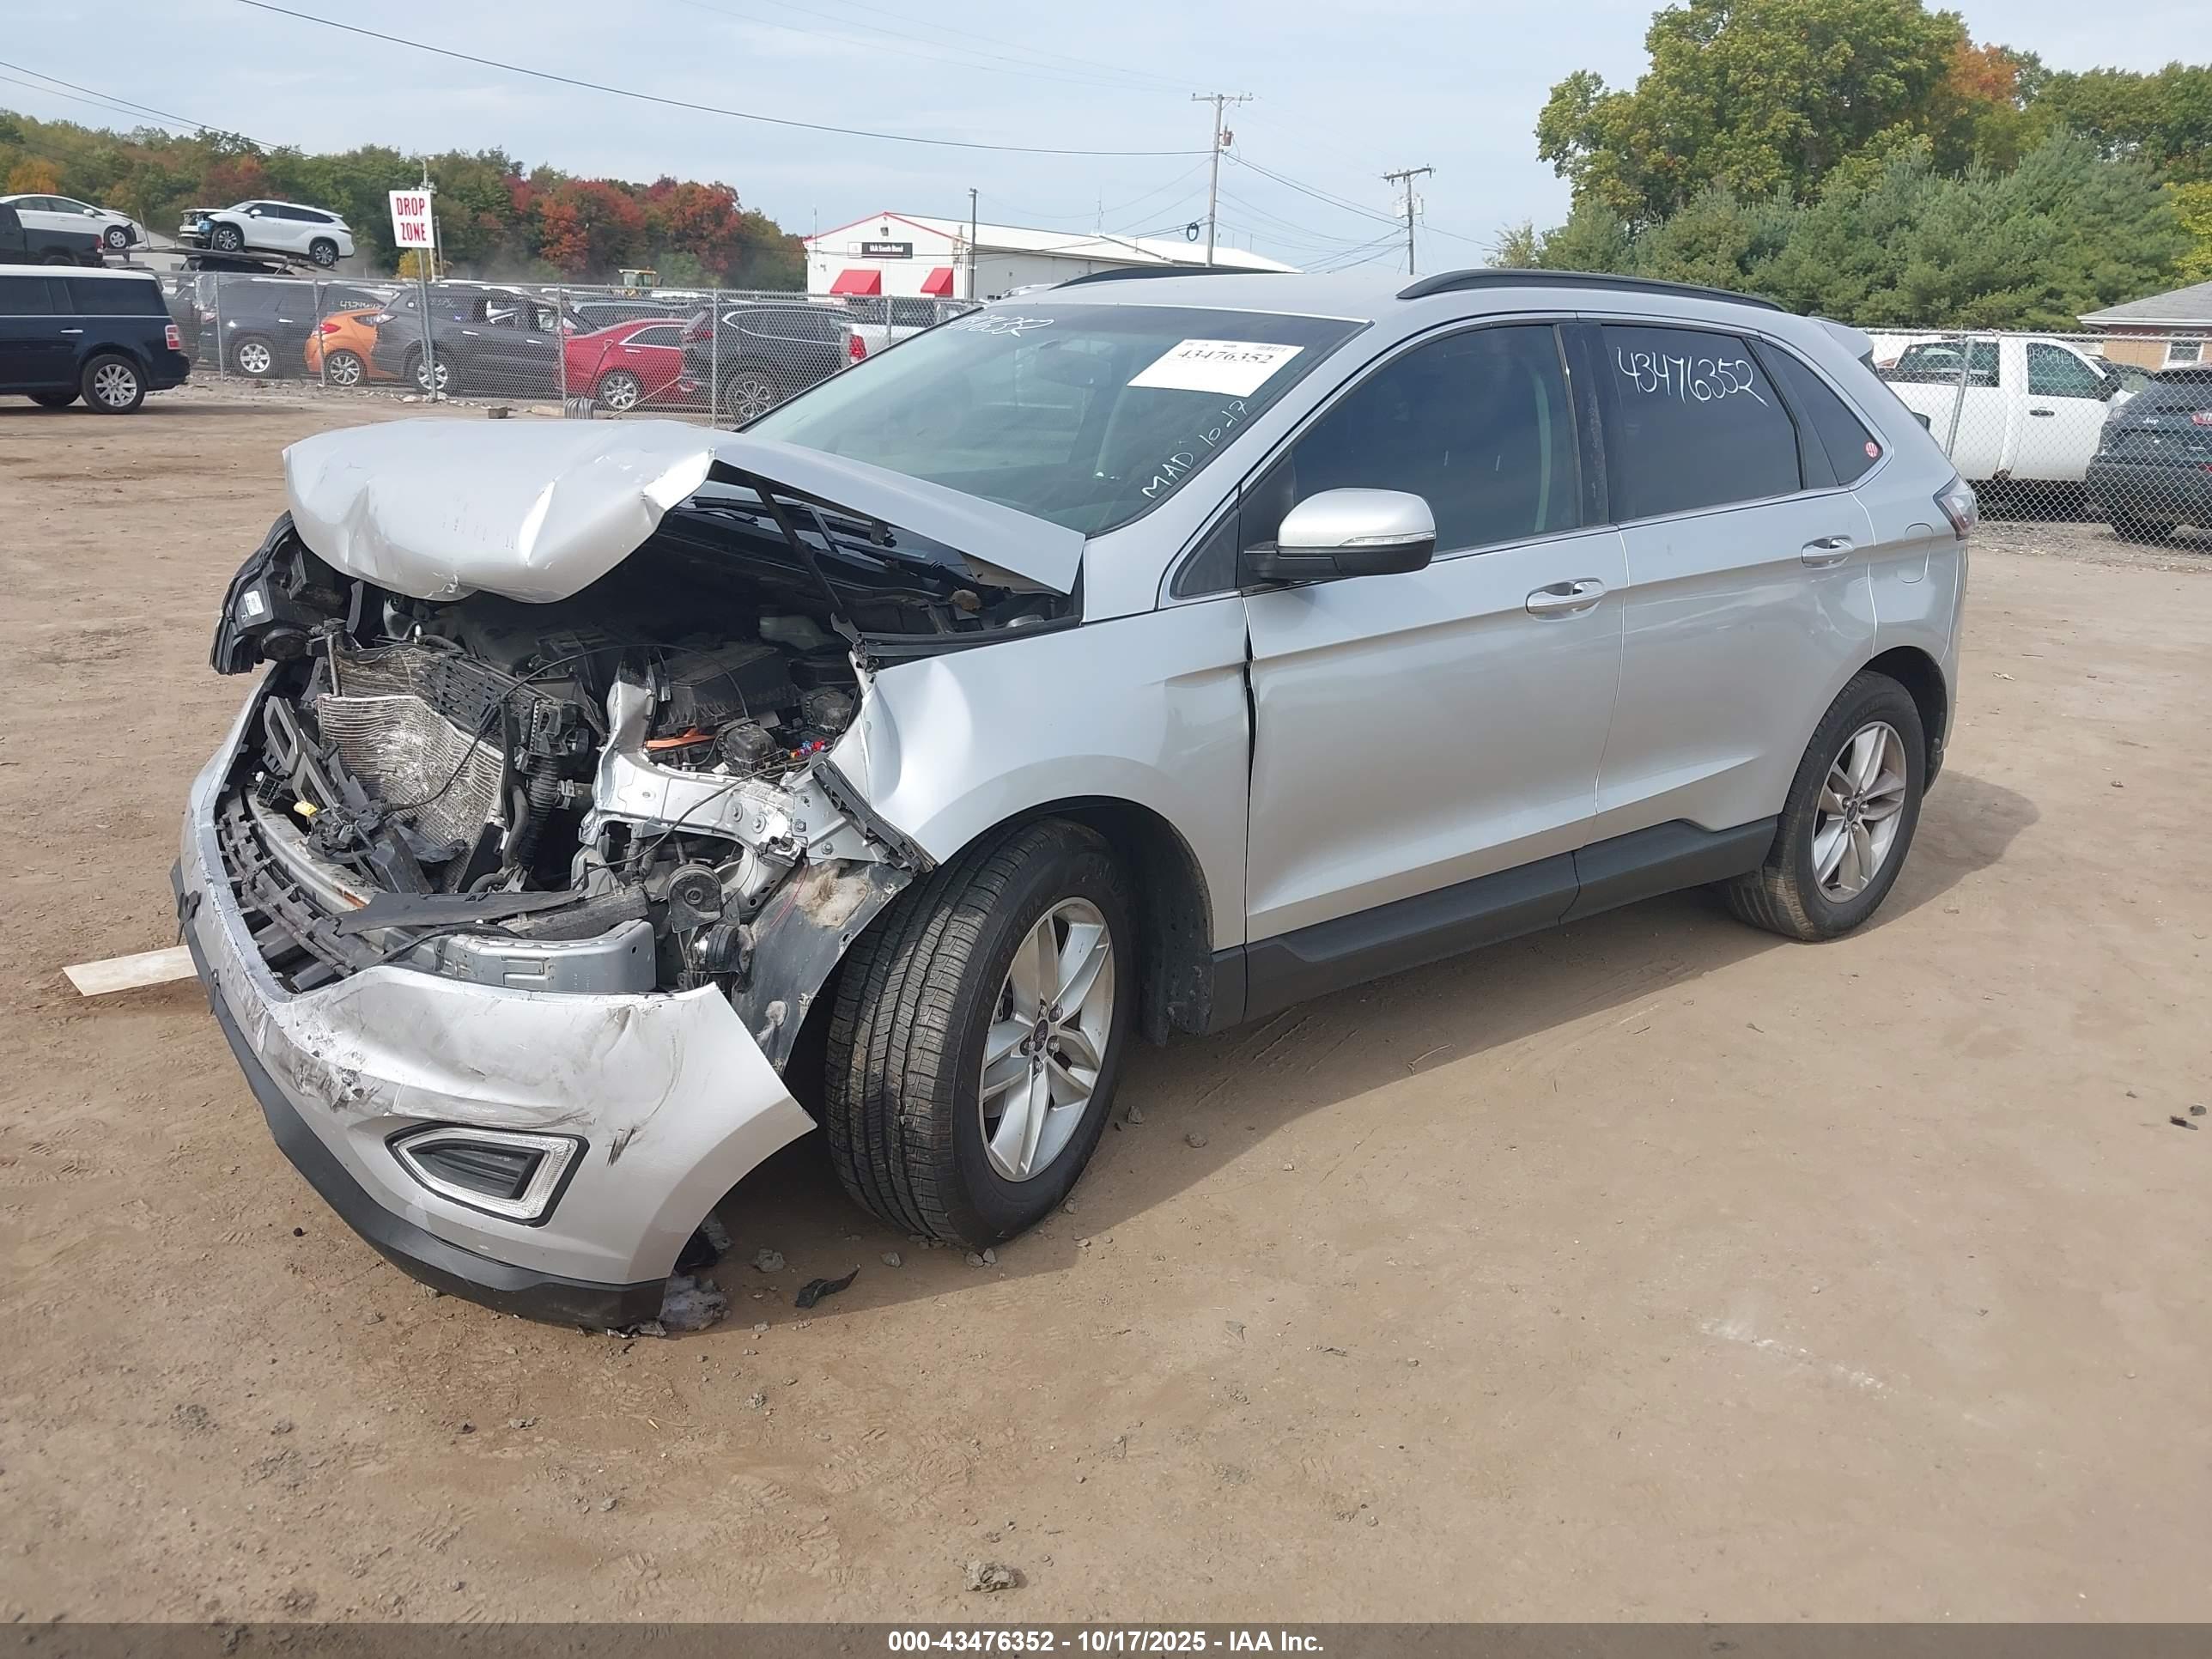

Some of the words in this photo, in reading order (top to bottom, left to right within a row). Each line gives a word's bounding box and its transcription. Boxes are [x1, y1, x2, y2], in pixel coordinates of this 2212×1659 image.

[396, 197, 426, 216] DROP
[400, 222, 428, 241] ZONE
[1177, 349, 1275, 365] 43476352
[1616, 346, 1770, 408] 43476352
[1141, 452, 1194, 499] MAD
